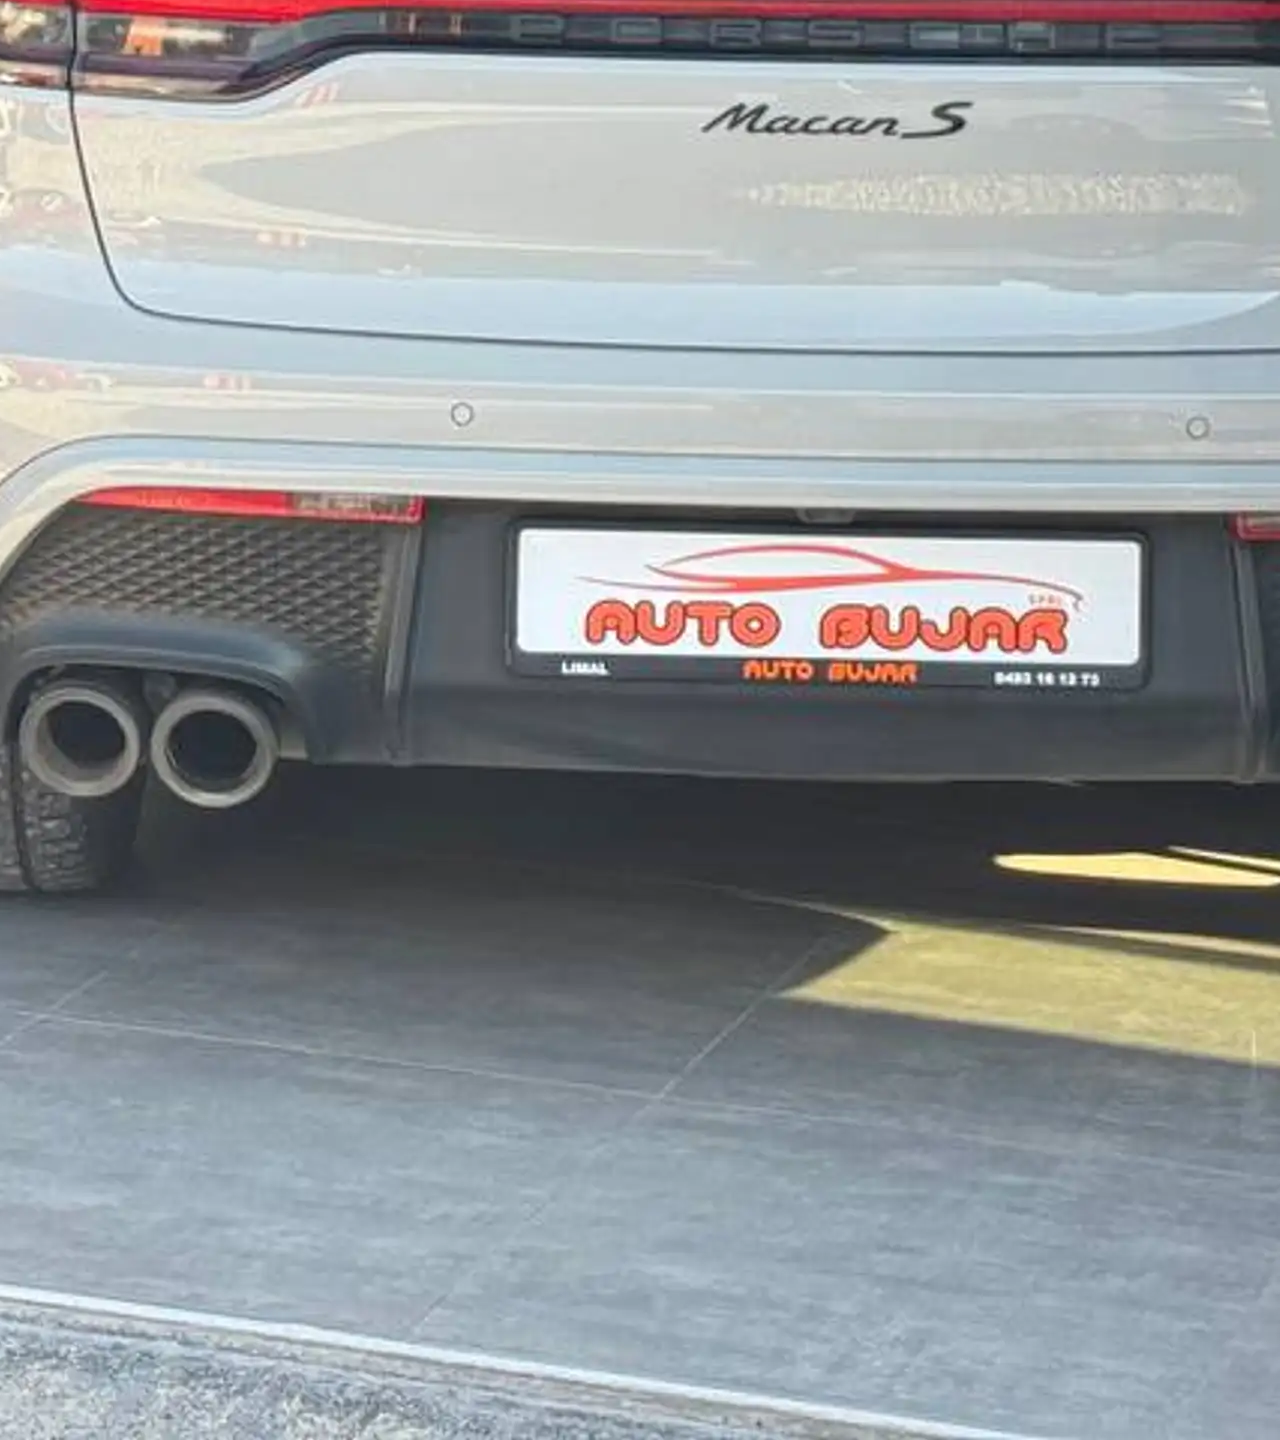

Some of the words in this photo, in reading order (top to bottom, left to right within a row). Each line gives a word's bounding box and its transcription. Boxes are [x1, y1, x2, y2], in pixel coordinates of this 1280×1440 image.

[701, 102, 899, 136] Macan
[901, 100, 973, 139] S
[585, 599, 782, 647] AUTO
[820, 603, 1068, 654] BUJAR
[743, 659, 815, 681] AUTO
[828, 661, 918, 684] BUJAR
